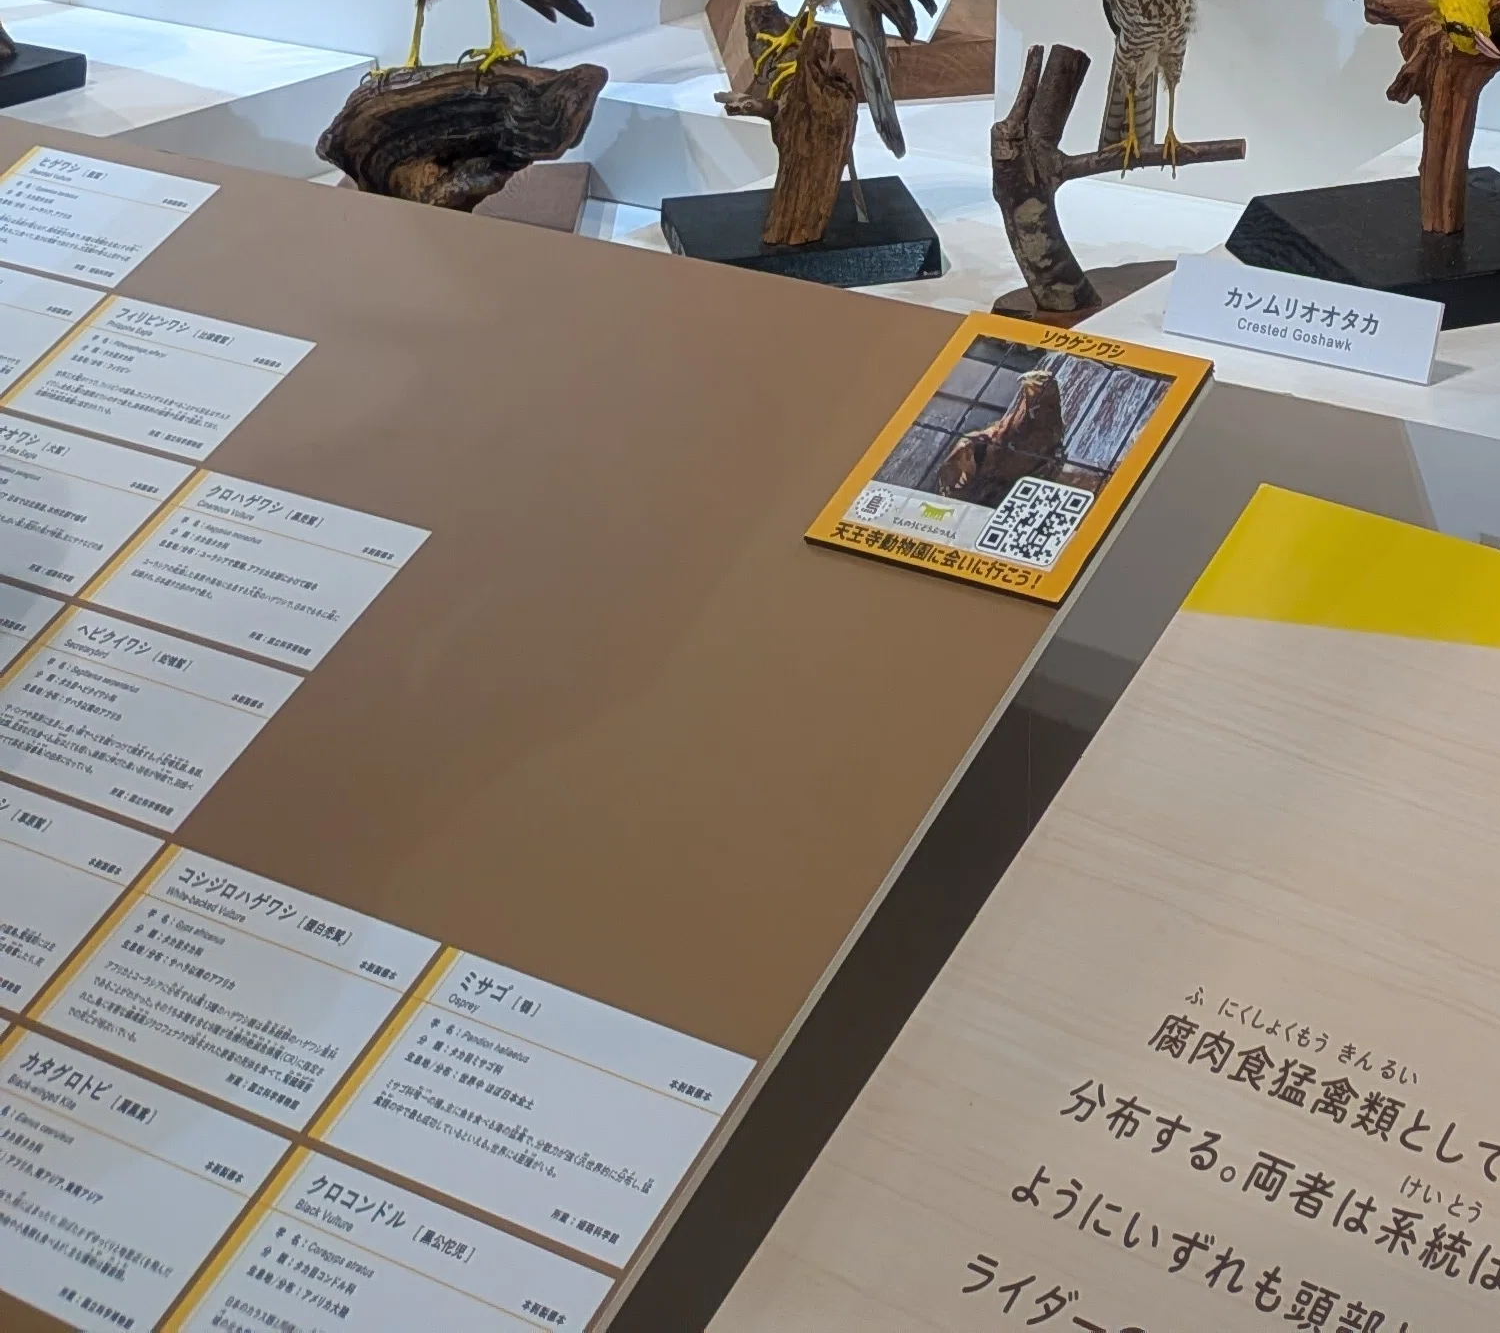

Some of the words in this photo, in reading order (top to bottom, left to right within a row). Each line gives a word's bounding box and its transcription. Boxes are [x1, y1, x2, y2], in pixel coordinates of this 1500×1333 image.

[1224, 285, 1380, 337] カンムリオオタカ
[1042, 330, 1125, 360] ソウゲンワシ
[1237, 316, 1287, 342] Crested
[1292, 328, 1352, 353] Goshawk
[205, 484, 285, 515] クロハゲワシ
[830, 522, 1044, 590] 天王寺動物園に会いに行こう！
[77, 625, 152, 656] ヘビクイワシ
[165, 886, 220, 913] White-backed
[217, 904, 246, 923] Vulture
[178, 867, 298, 921] コシジロハゲワシ
[448, 993, 481, 1015] Osprey
[460, 971, 514, 1003] ミサゴ
[1185, 987, 1204, 1007] ふ
[19, 1051, 113, 1101] カタグロトビ
[294, 1198, 322, 1218] Black
[321, 1208, 354, 1233] Vulture
[306, 1175, 406, 1229] クロコンドル
[1011, 1165, 1410, 1333] ようにいずれも頭部
[962, 1254, 1147, 1333] ライダー
